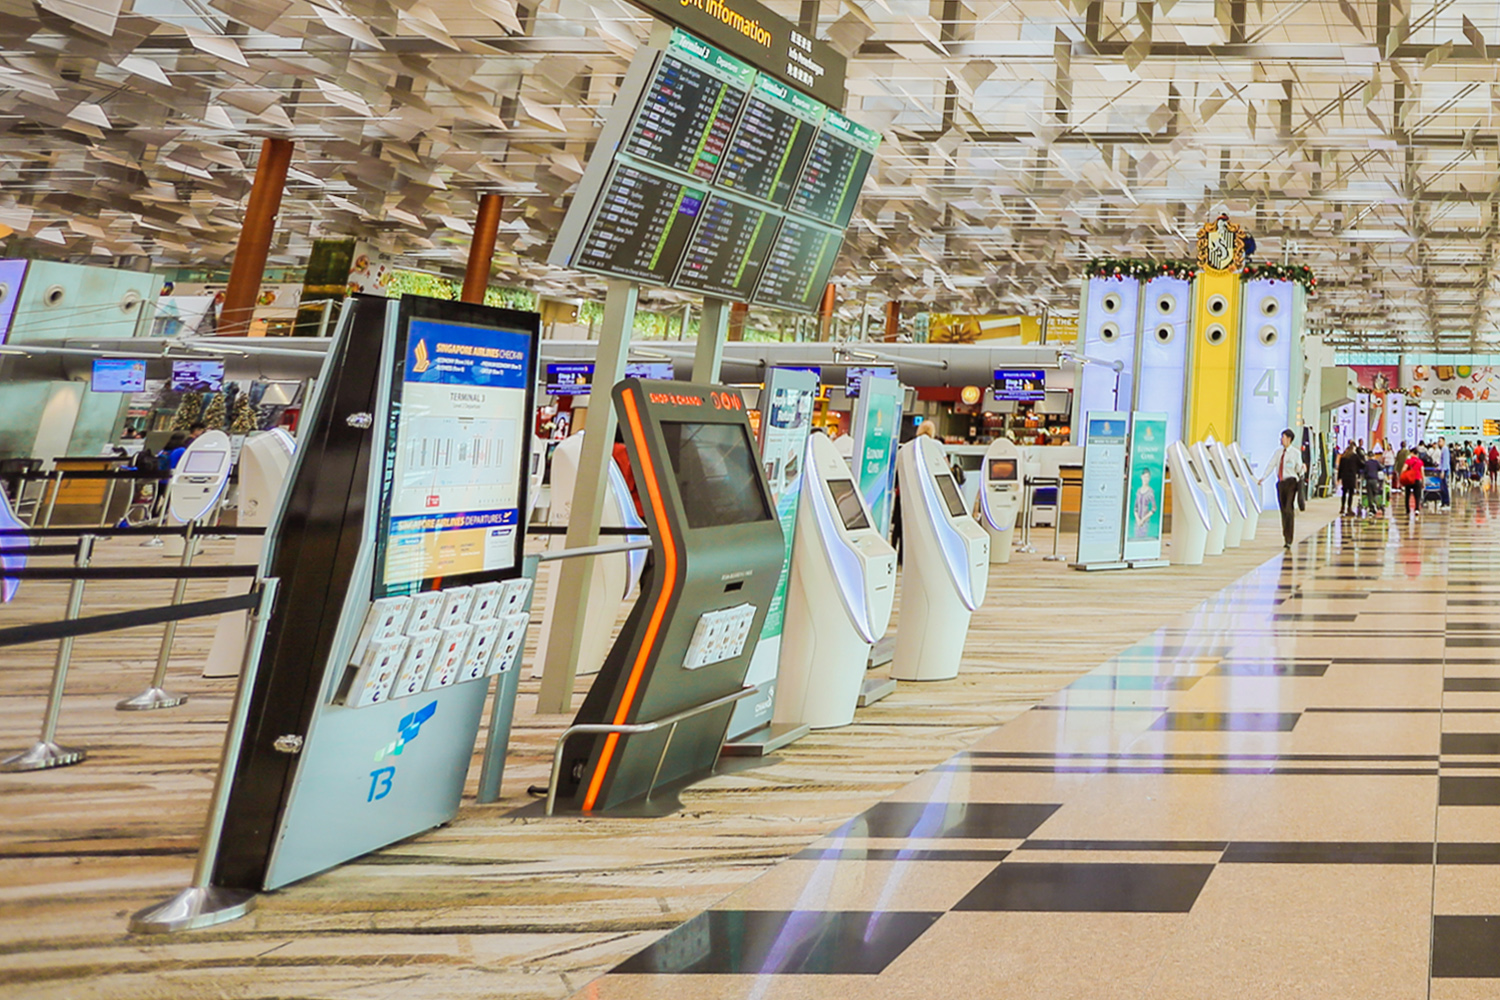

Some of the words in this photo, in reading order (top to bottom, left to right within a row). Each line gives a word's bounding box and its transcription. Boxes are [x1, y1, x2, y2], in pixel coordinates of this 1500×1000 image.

[679, 35, 706, 57] Terminal
[762, 78, 784, 98] Terminal
[435, 342, 473, 356] SINGAPORE
[472, 347, 500, 359] AIRLINES
[1253, 368, 1279, 404] 4
[1432, 387, 1450, 396] dine
[1391, 422, 1399, 435] 6
[1407, 427, 1414, 438] 8
[435, 515, 465, 528] AIRLINES
[465, 513, 503, 526] DEPARTURES
[367, 766, 396, 803] T3
